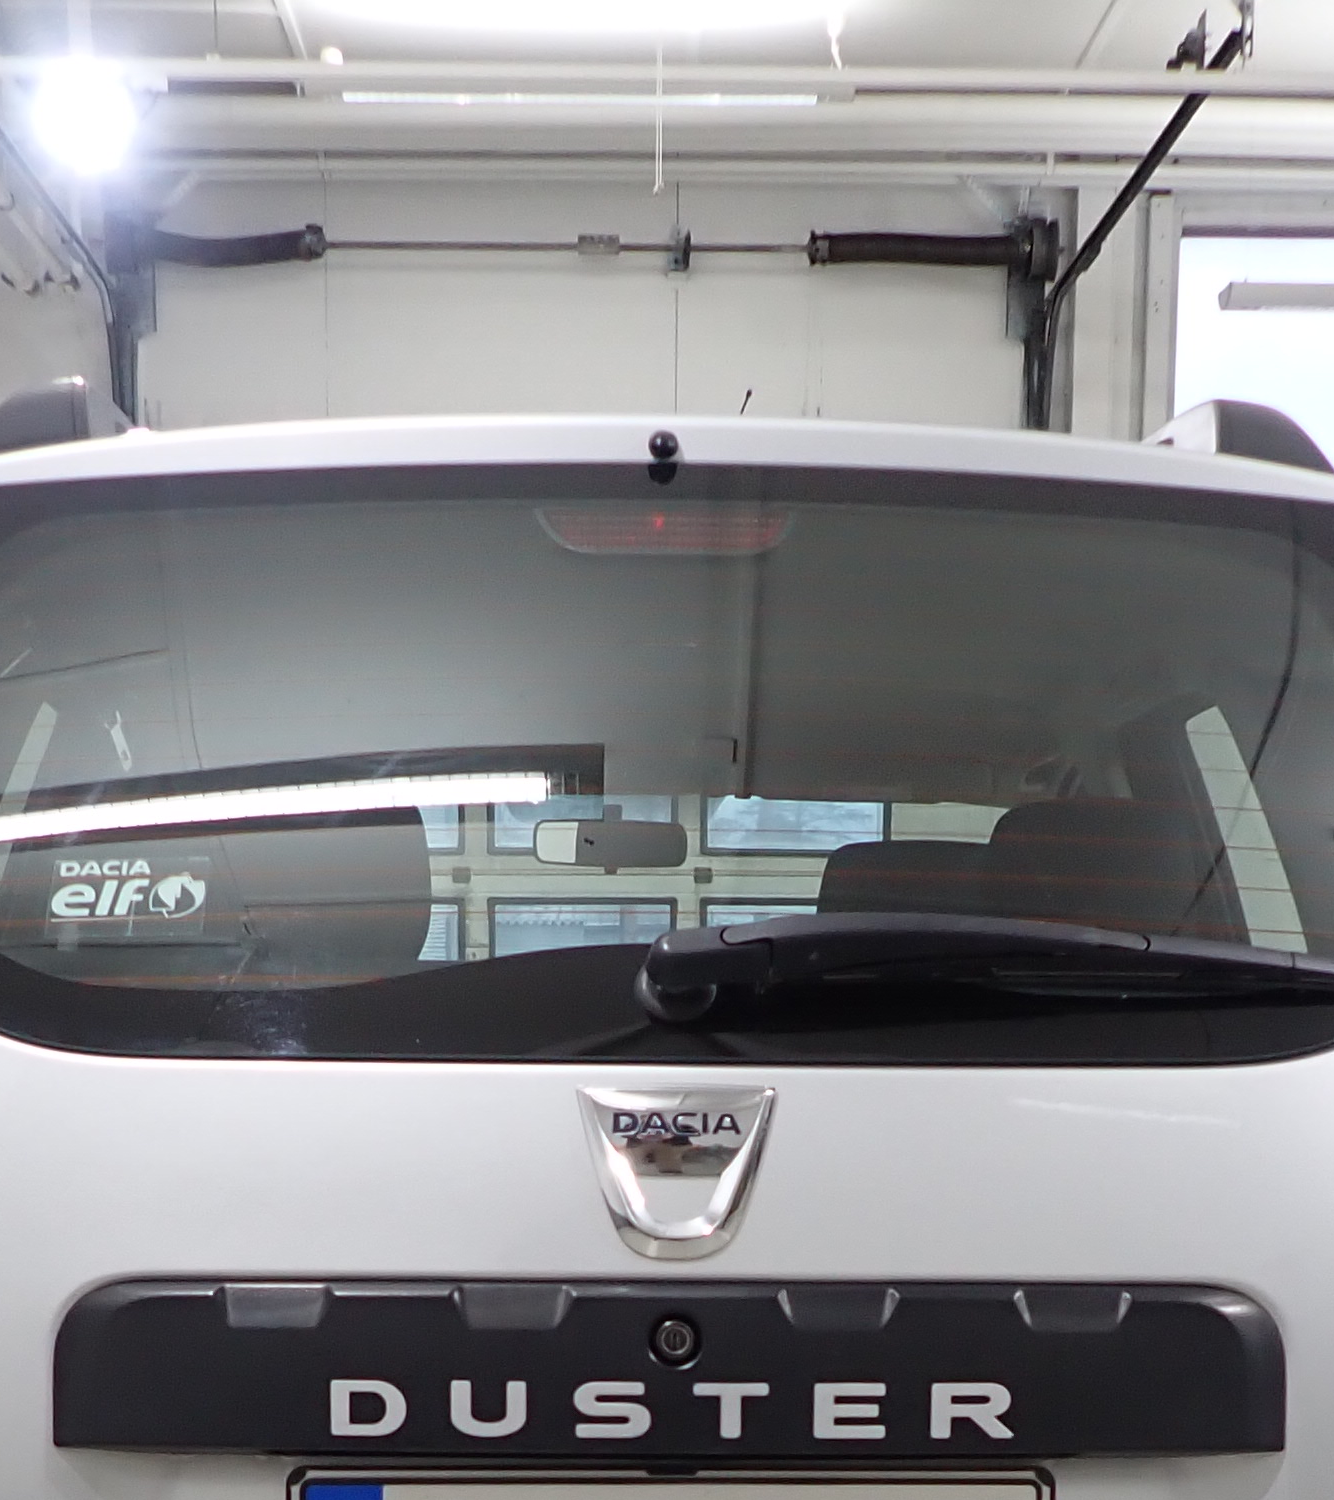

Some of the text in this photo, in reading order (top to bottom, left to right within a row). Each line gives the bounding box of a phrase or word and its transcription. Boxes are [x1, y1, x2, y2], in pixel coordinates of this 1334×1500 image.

[59, 860, 152, 877] DACIA
[51, 878, 150, 917] elf
[611, 1111, 742, 1136] DACIA
[328, 1379, 1015, 1440] DUSTER
